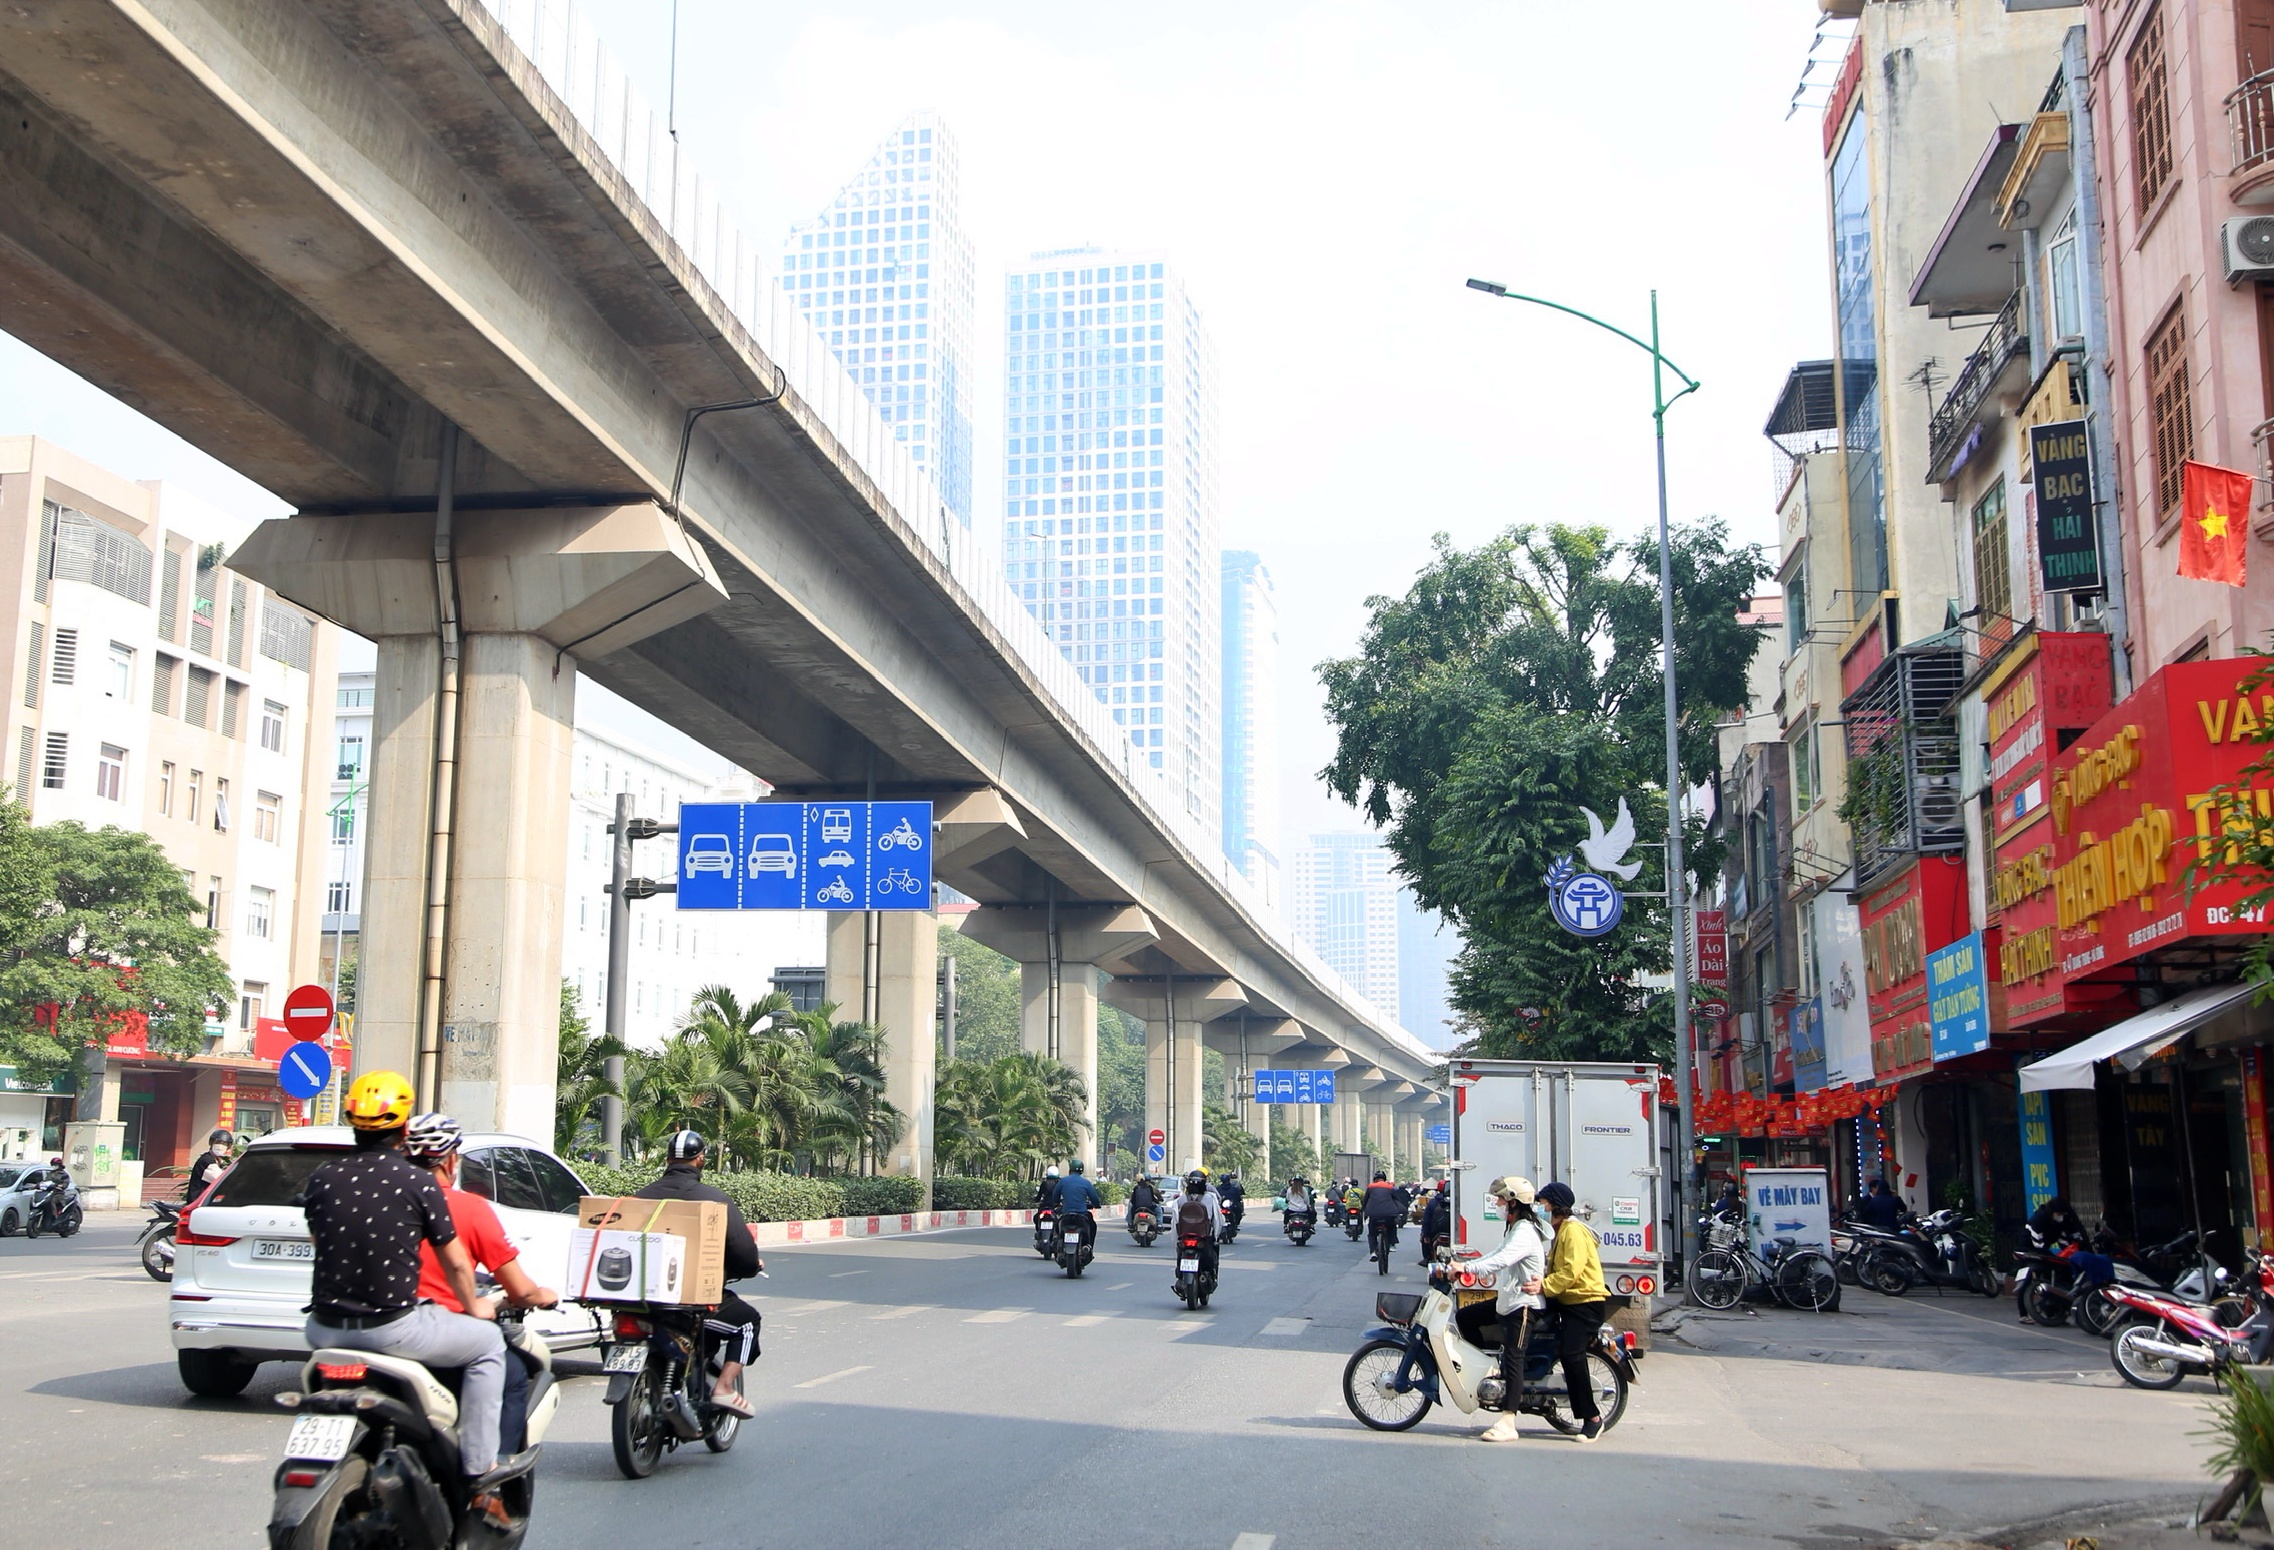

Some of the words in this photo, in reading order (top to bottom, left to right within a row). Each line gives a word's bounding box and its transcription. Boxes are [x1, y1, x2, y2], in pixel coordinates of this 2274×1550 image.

[2036, 434, 2086, 463] VÀNG
[2044, 473, 2084, 503] BẠC
[2053, 507, 2082, 540] HẢI
[2045, 550, 2098, 581] THỊNH
[2053, 832, 2116, 933] THIỆN
[2113, 803, 2172, 912] HỢP
[1698, 917, 1723, 932] Xinh
[1702, 939, 1721, 954] Áo
[1702, 959, 1723, 971] Dài
[1701, 978, 1726, 987] Trang
[1584, 1126, 1631, 1134] FRONTIER
[2026, 1117, 2047, 1145] SÀN
[2030, 1163, 2049, 1187] PVC
[1800, 1187, 1820, 1205] BAY
[628, 1235, 661, 1244] CUCOO
[1469, 1292, 1487, 1300] 29K
[288, 1437, 344, 1457] 637.95
